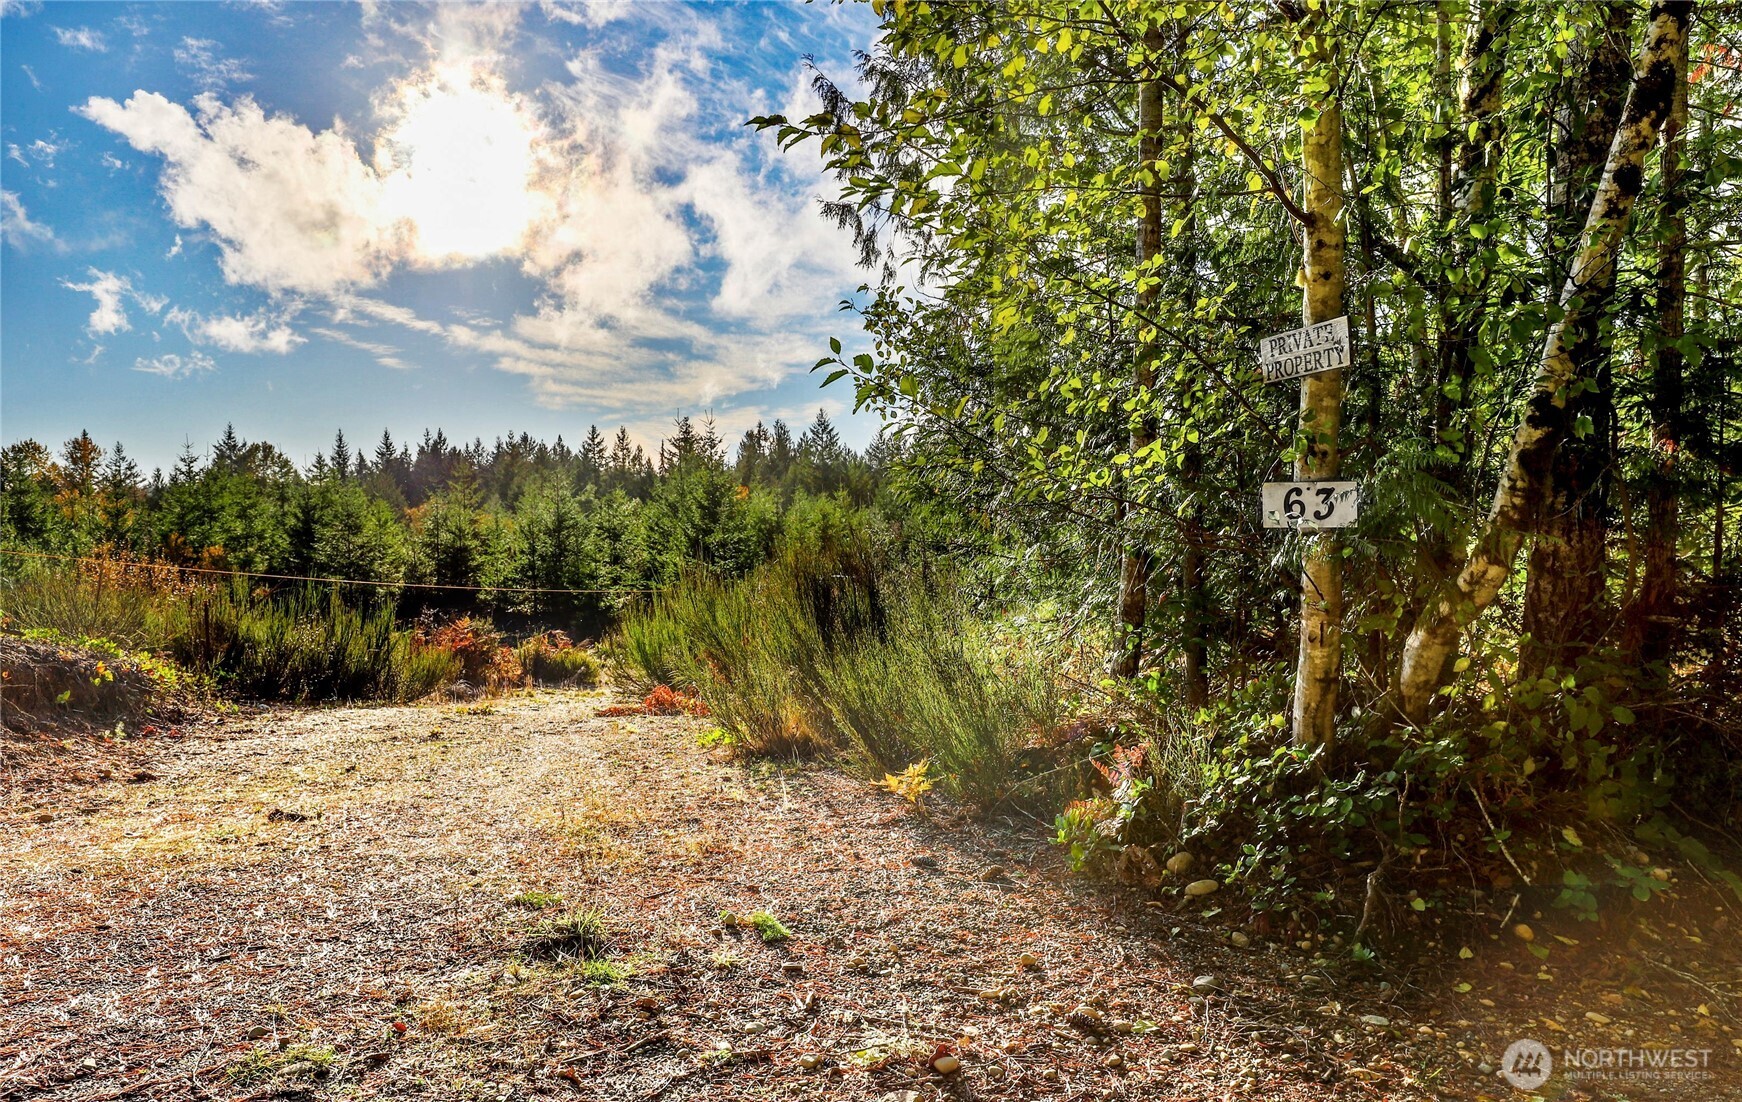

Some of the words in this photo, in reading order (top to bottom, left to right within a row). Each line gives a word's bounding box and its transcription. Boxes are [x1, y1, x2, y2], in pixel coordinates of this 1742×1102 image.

[1268, 323, 1334, 358] PRIVATE
[1266, 345, 1345, 381] PROPERTY
[1283, 487, 1336, 520] 63
